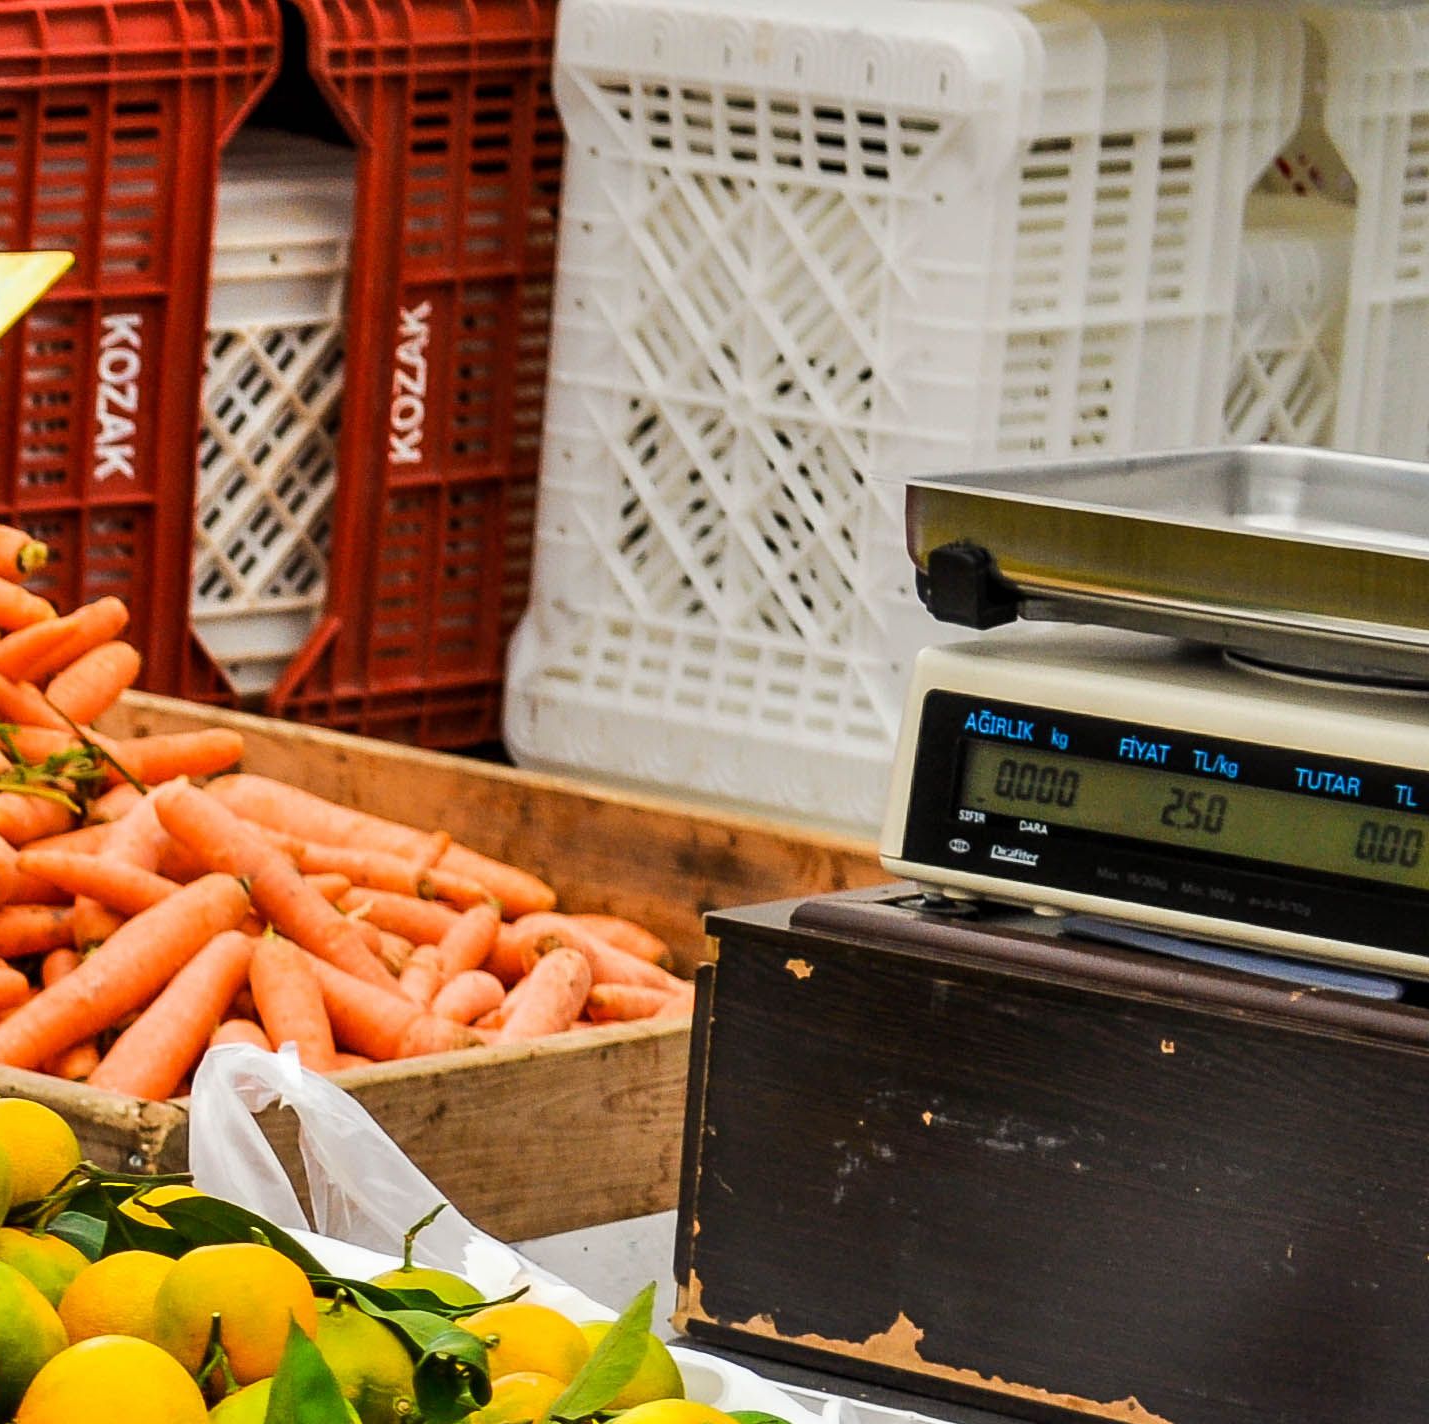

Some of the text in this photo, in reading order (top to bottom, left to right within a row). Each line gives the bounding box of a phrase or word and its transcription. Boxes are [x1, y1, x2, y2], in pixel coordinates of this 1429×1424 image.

[94, 315, 140, 479] KOZAK
[389, 303, 431, 463] KOZAK
[964, 710, 1418, 807] AĞIRLIK kg FİYAT TL/kg TUTAR TL
[1019, 820, 1048, 835] DARA
